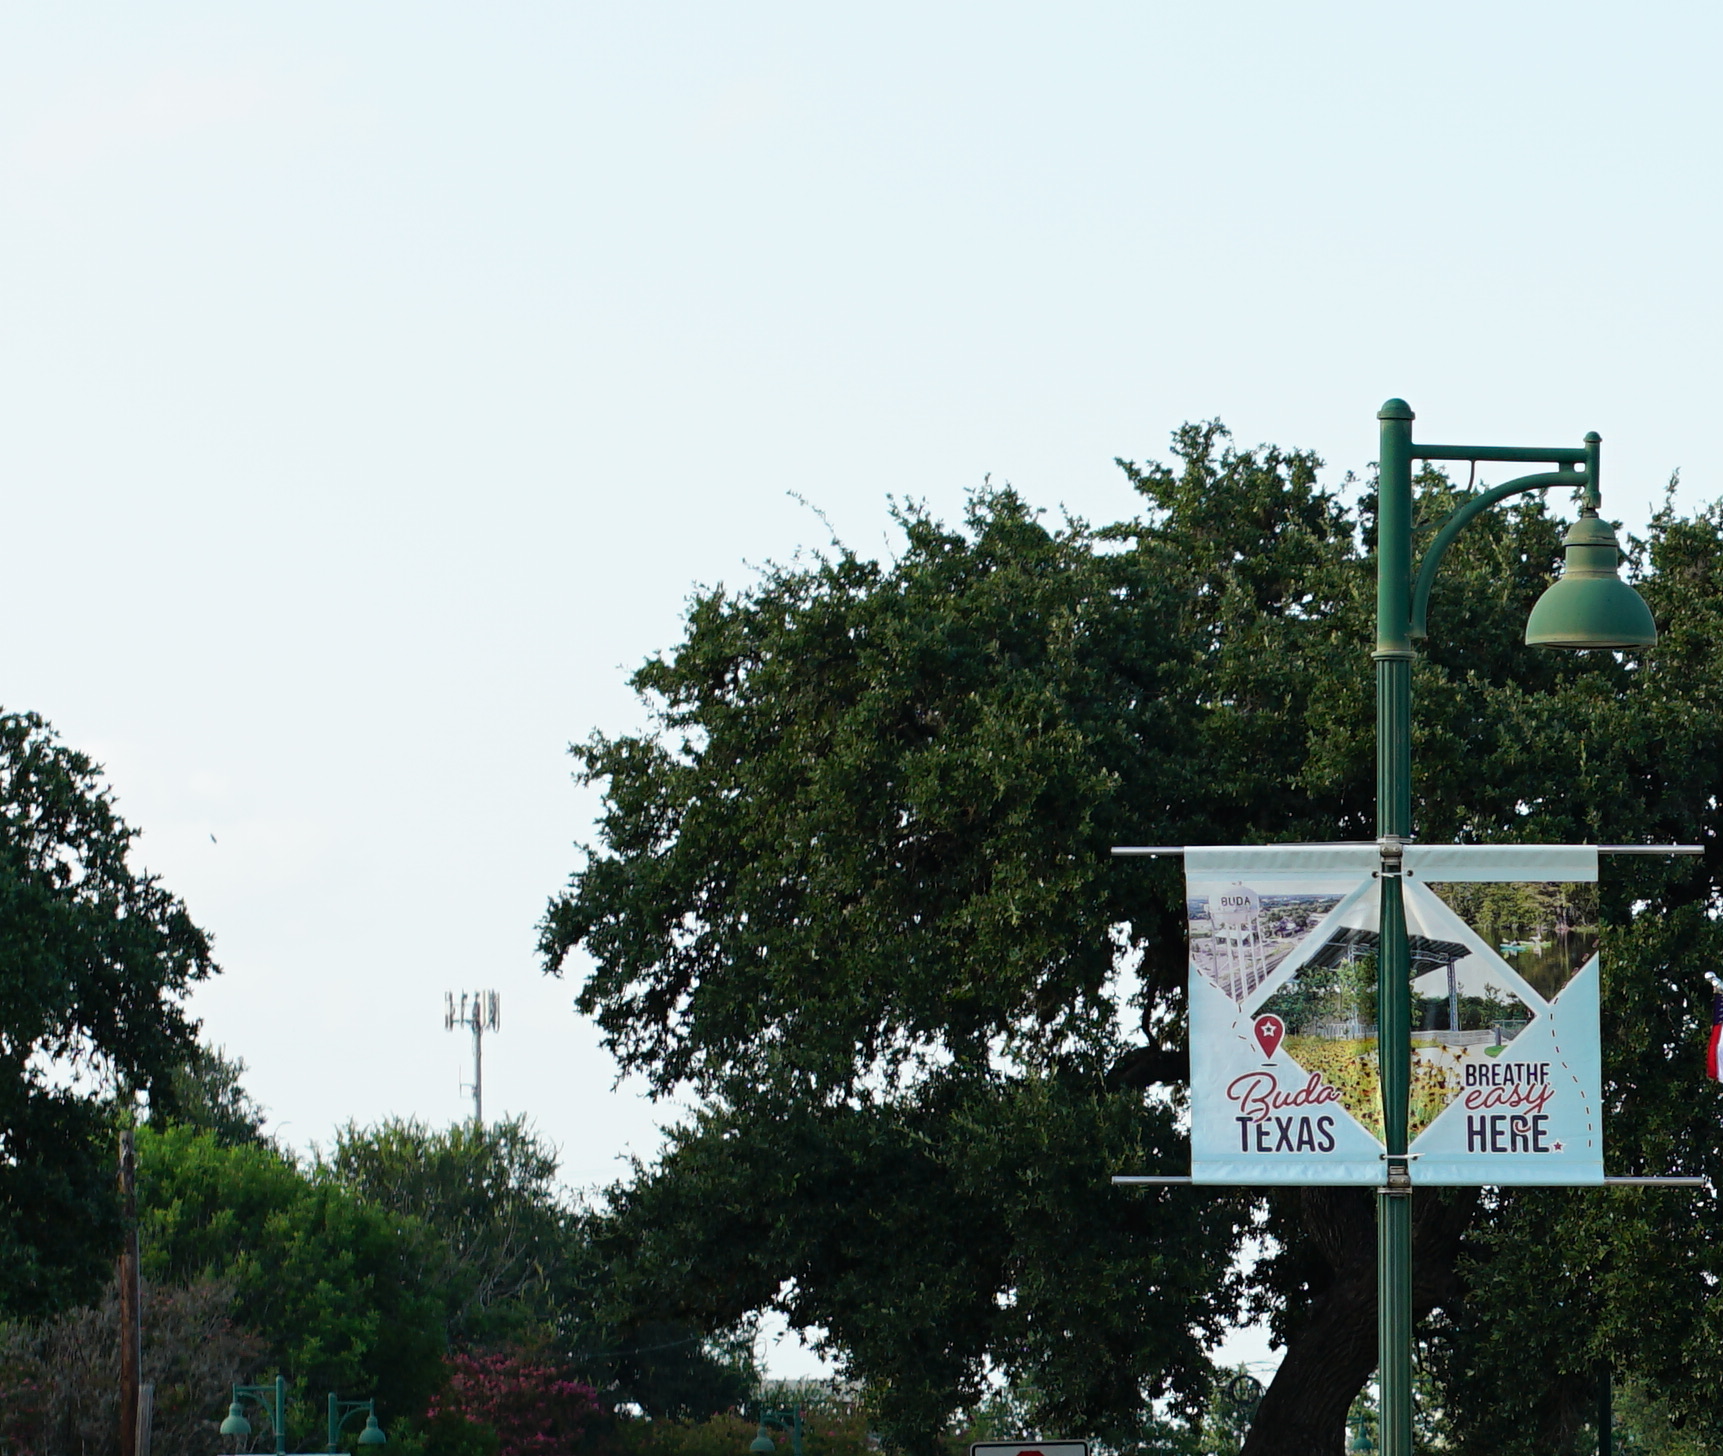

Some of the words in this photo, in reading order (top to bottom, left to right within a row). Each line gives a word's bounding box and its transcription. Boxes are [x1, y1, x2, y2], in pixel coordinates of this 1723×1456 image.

[1220, 896, 1251, 907] BUDA
[1465, 1063, 1550, 1087] BREATHE
[1226, 1071, 1341, 1123] Buda
[1464, 1082, 1555, 1133] easy
[1235, 1115, 1336, 1153] TEXAS
[1467, 1114, 1550, 1153] HERE
